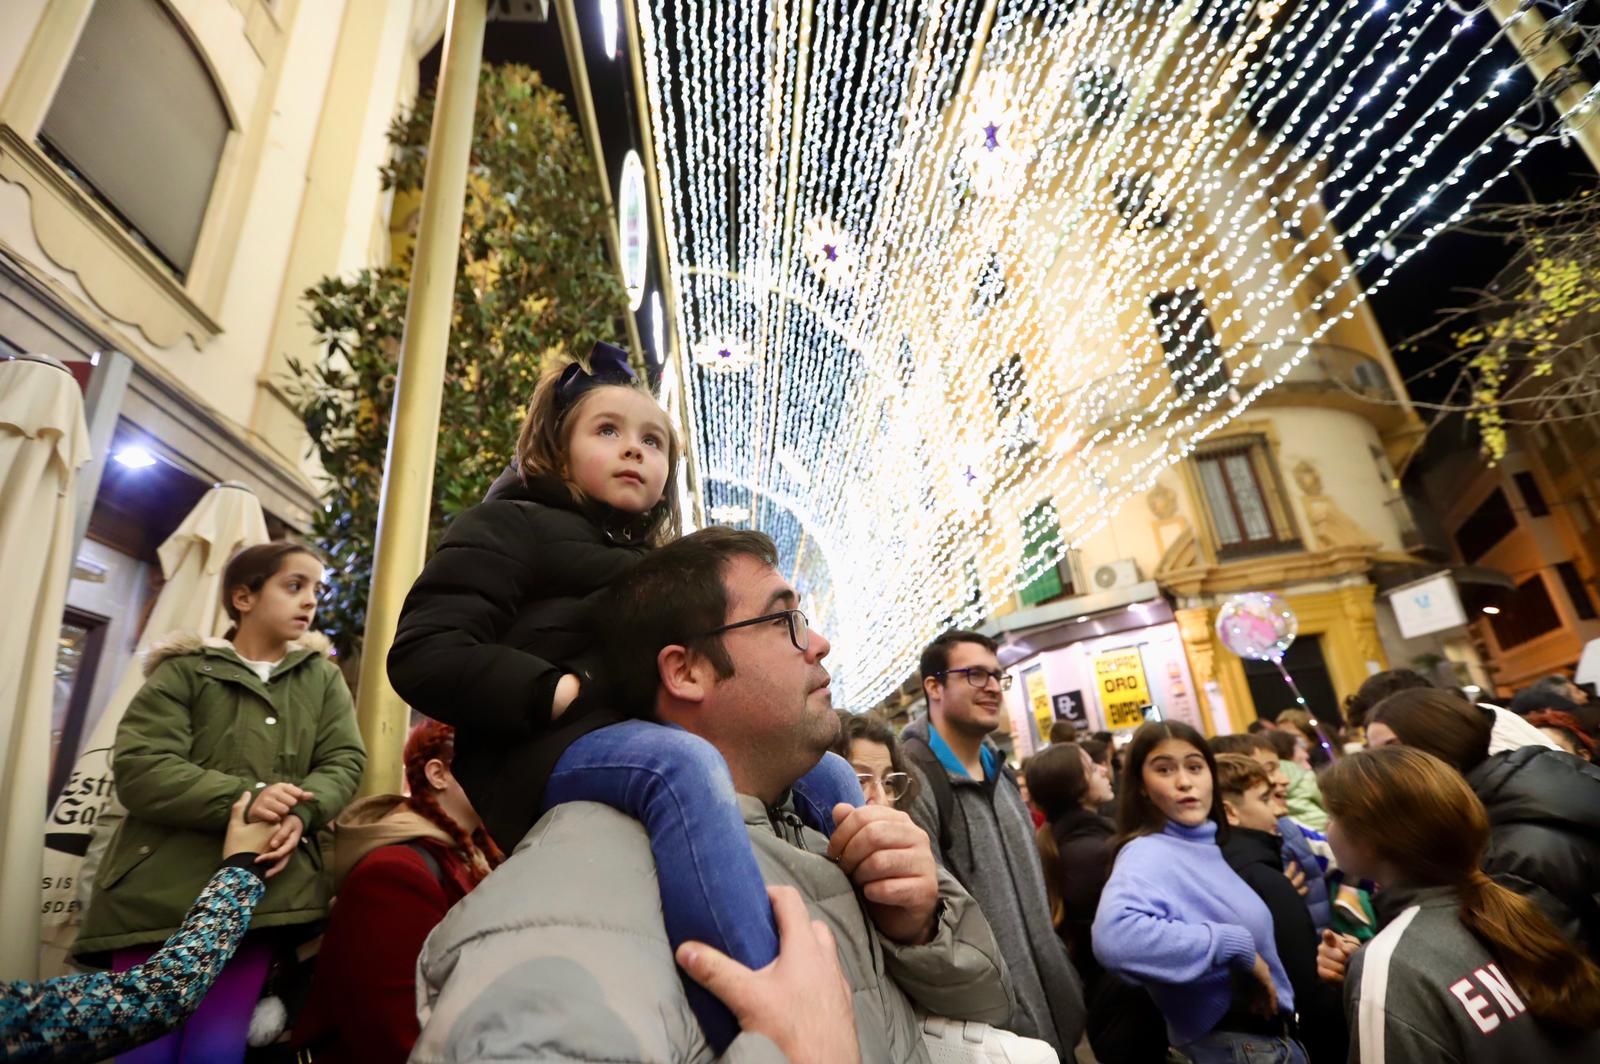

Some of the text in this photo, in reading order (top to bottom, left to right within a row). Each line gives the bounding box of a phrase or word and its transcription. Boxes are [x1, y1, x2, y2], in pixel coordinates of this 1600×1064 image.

[1104, 675, 1138, 693] ORO
[1109, 700, 1146, 725] EMPE
[1448, 961, 1528, 1035] EN
